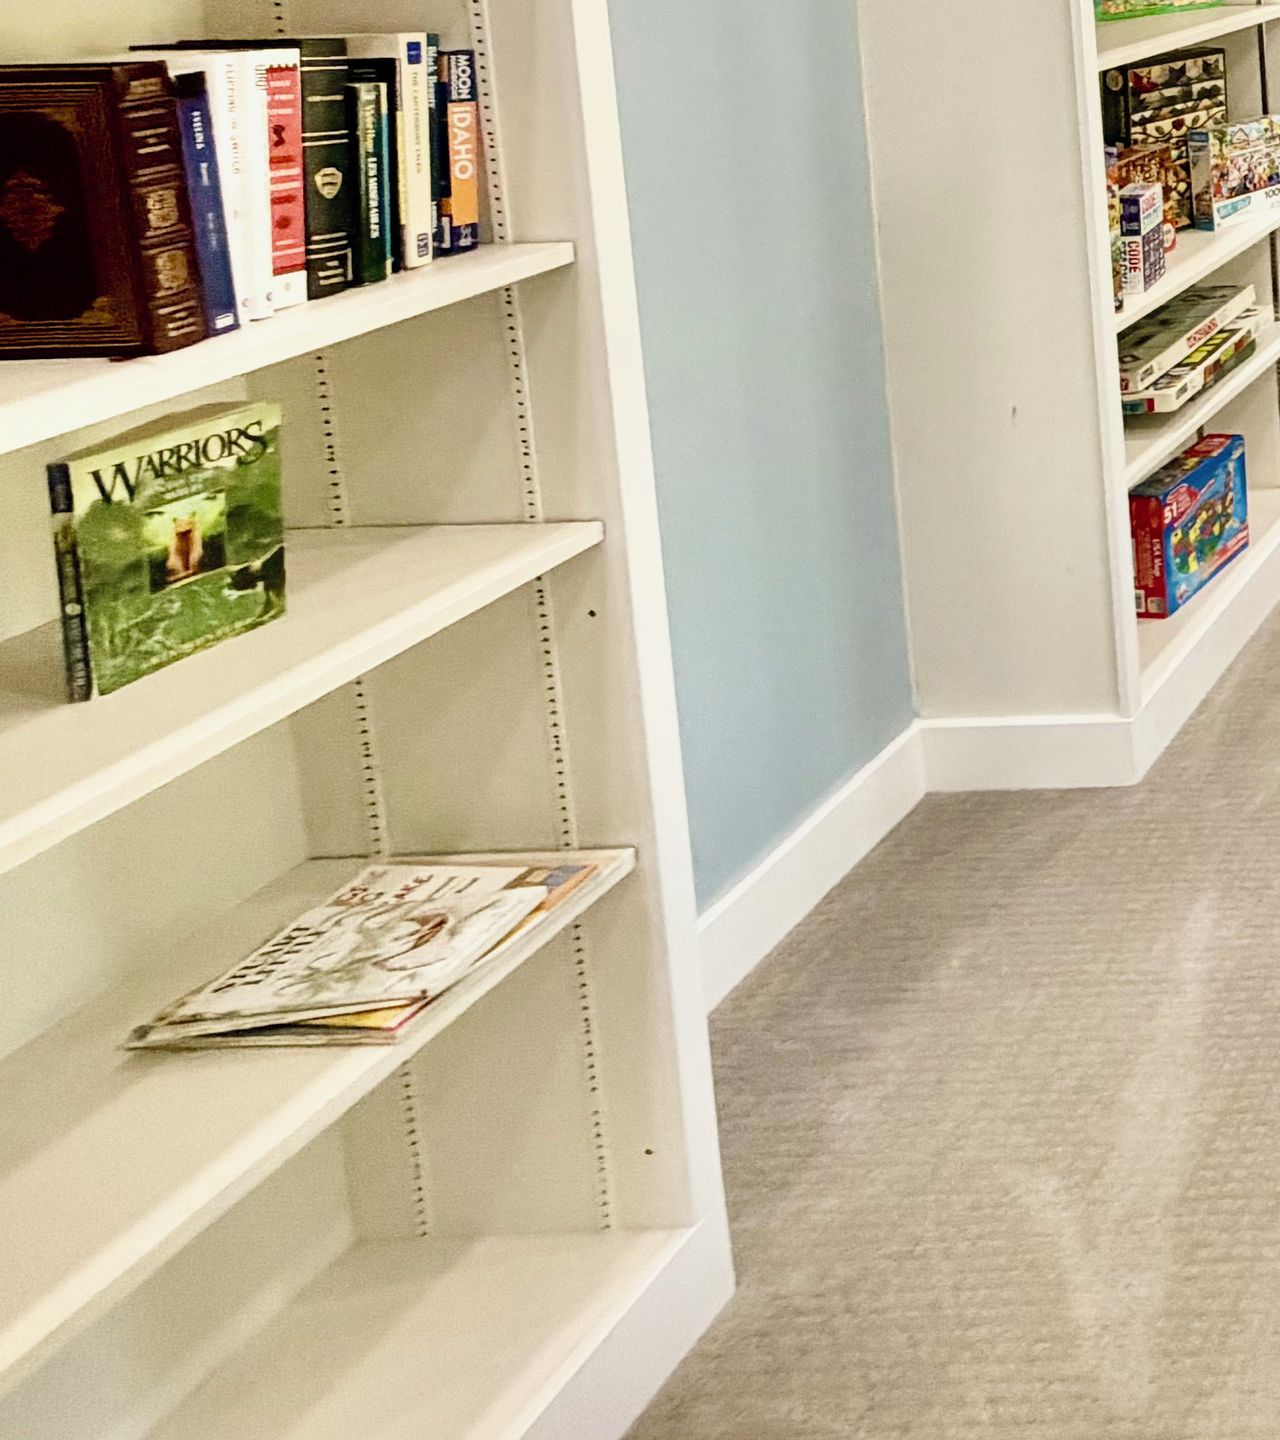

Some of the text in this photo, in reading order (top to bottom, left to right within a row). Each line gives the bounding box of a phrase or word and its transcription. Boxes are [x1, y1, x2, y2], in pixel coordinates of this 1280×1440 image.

[456, 53, 472, 100] MOON
[451, 104, 474, 181] IDAHO
[1128, 240, 1141, 273] CODE
[88, 420, 268, 504] WARRIORS
